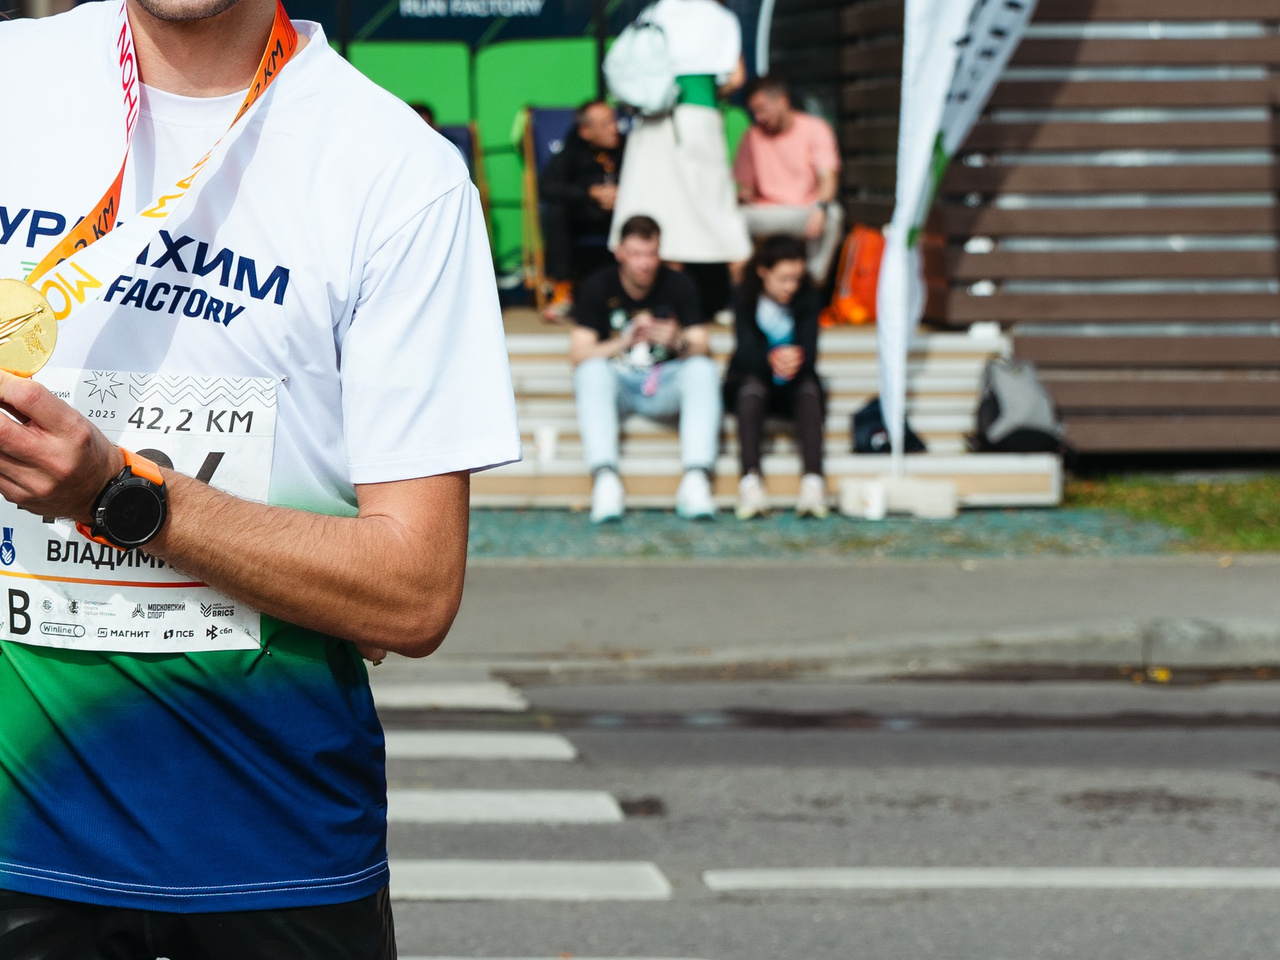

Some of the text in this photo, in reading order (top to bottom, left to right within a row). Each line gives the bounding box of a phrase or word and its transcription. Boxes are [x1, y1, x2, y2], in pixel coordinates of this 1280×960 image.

[103, 274, 246, 327] FACTORY
[88, 409, 116, 419] 2025
[127, 406, 193, 434] 42,2
[46, 539, 174, 570] ВЛАДИМ
[147, 602, 186, 611] МОСКОВСКИЙ
[147, 611, 166, 619] СПОРТ
[212, 609, 235, 617] BRICS
[43, 625, 72, 634] Winline
[110, 629, 150, 638] МАГНИТ
[176, 630, 195, 638] ПСБ
